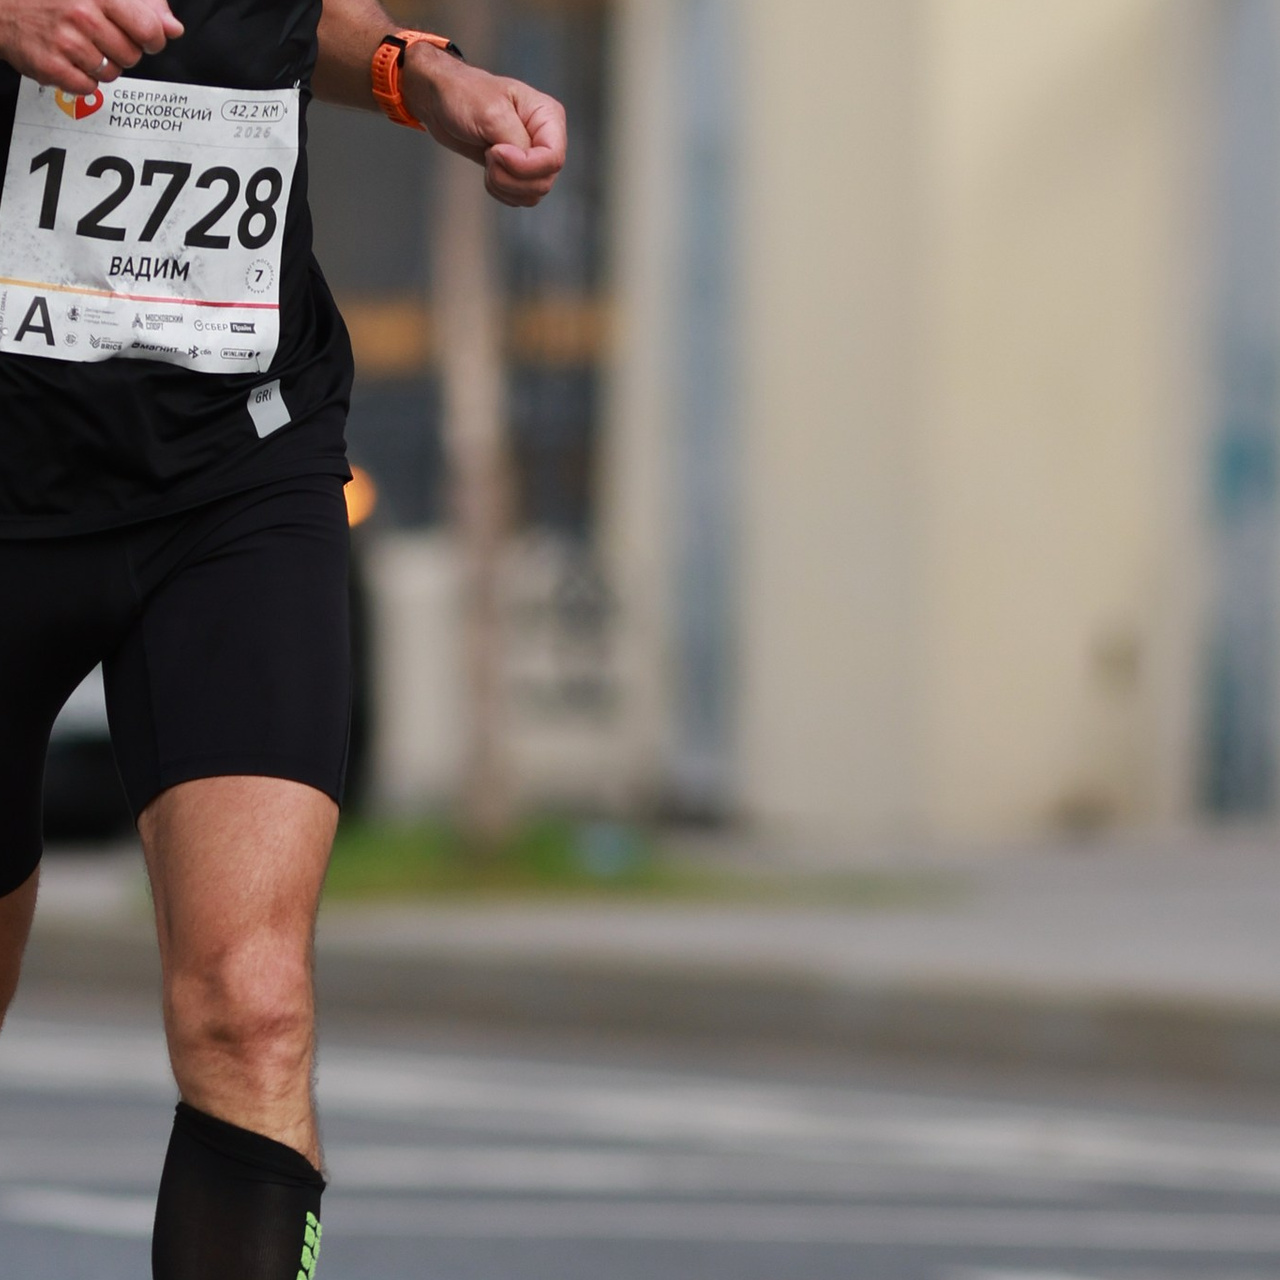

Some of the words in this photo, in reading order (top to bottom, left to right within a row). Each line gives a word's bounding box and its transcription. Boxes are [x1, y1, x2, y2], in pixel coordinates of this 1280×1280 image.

[113, 89, 188, 104] СБЕРПРАЙМ
[111, 101, 213, 122] МОСКОВСКИЙ
[229, 104, 259, 120] 42,2
[261, 105, 279, 118] КМ
[109, 115, 183, 132] МАРАФОН
[28, 146, 283, 250] 12728
[108, 255, 190, 281] ВАДИМ
[255, 269, 264, 283] 7
[145, 313, 184, 324] МОСКОВСКИЙ
[204, 322, 228, 331] СБЕР
[100, 343, 122, 351] BRICS
[255, 388, 273, 404] GRi
